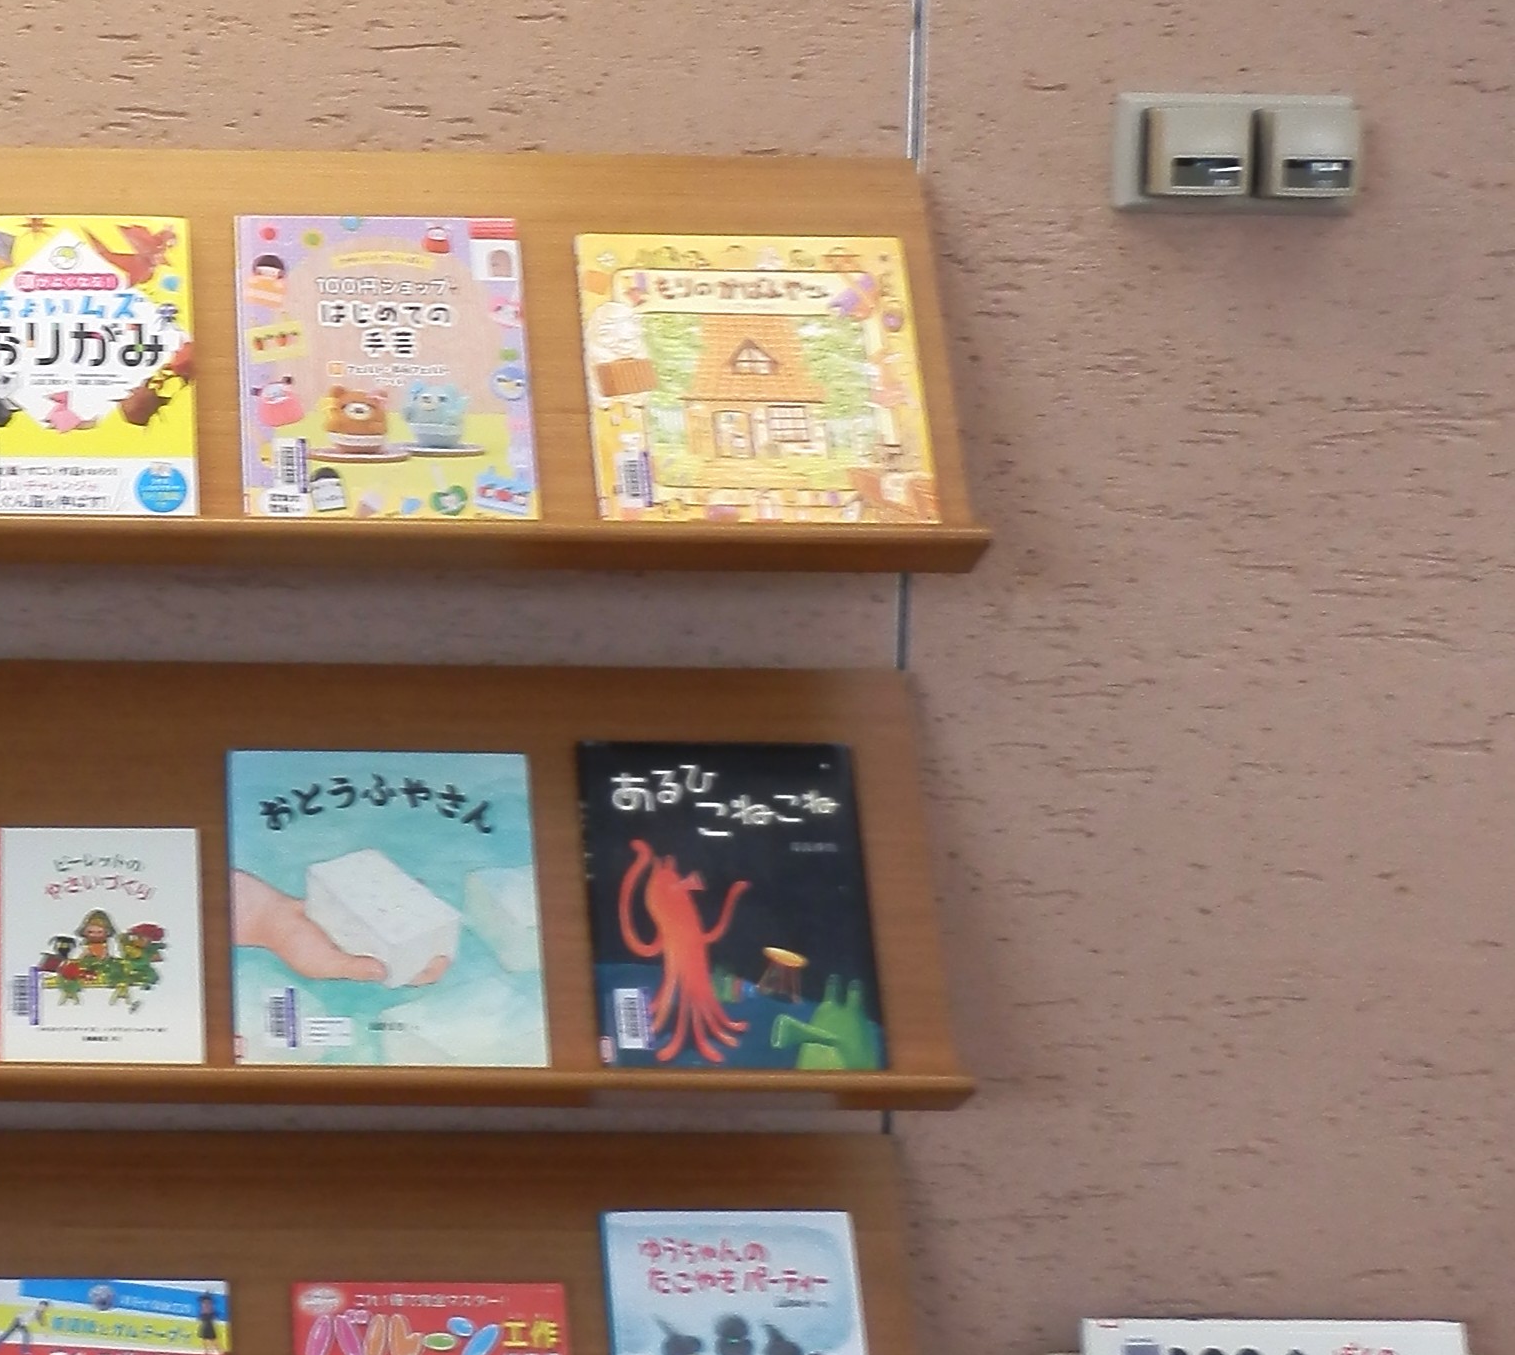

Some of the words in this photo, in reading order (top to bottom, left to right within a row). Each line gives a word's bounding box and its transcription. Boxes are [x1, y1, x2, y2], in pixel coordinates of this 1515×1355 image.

[318, 301, 452, 327] はじめての
[259, 773, 493, 834] おとうふやさん
[610, 763, 720, 812] あるひ
